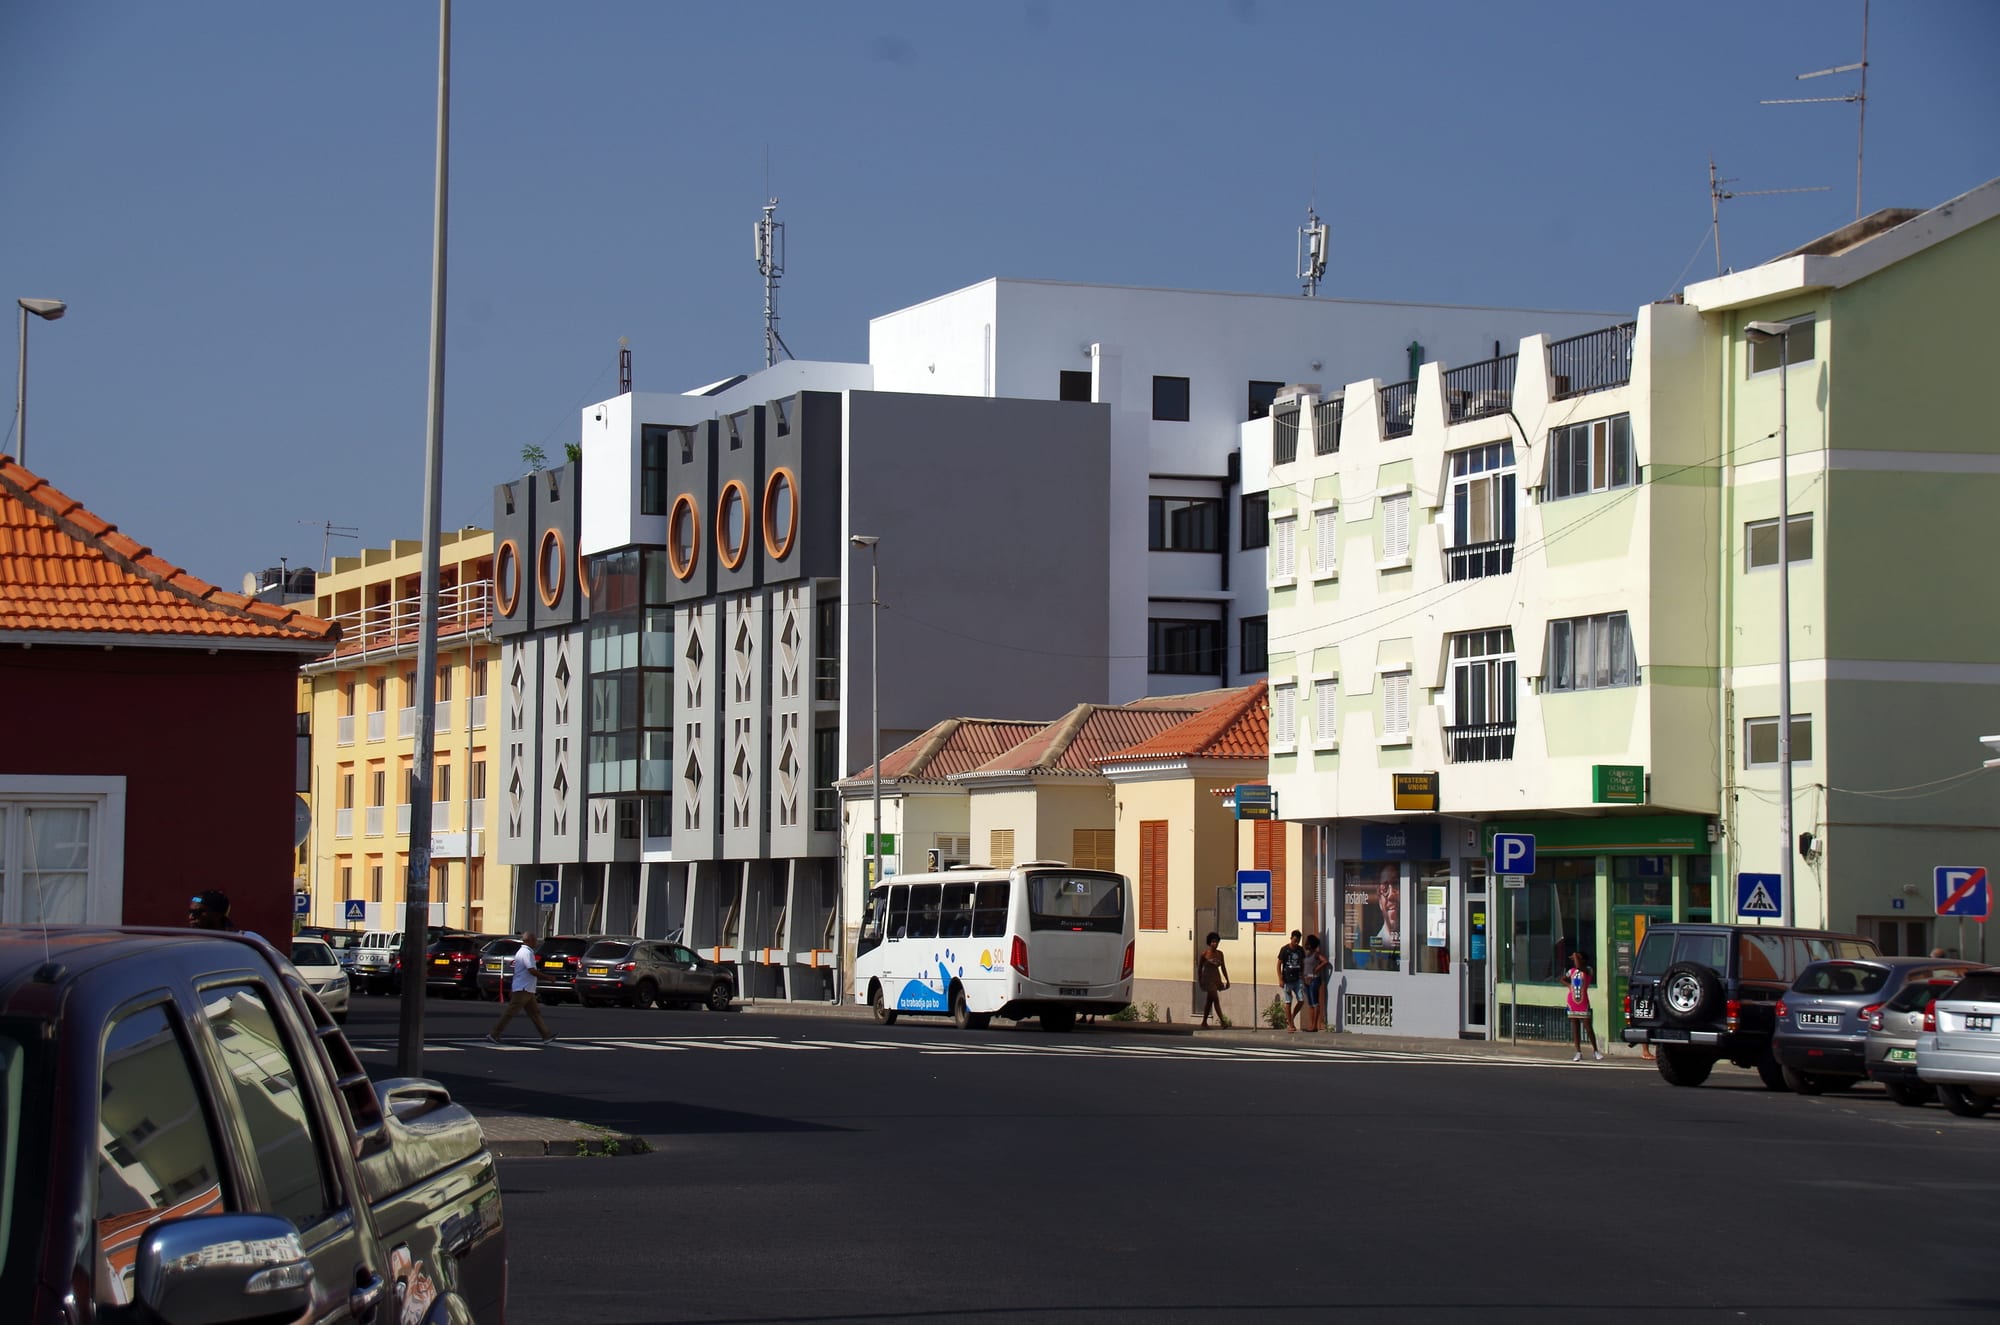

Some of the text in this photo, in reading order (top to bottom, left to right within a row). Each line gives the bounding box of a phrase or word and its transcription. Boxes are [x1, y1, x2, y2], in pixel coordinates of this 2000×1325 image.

[1503, 838, 1526, 870] P
[541, 882, 554, 902] P
[1345, 890, 1369, 904] instante
[295, 896, 307, 912] P
[355, 954, 385, 962] TOYOTA
